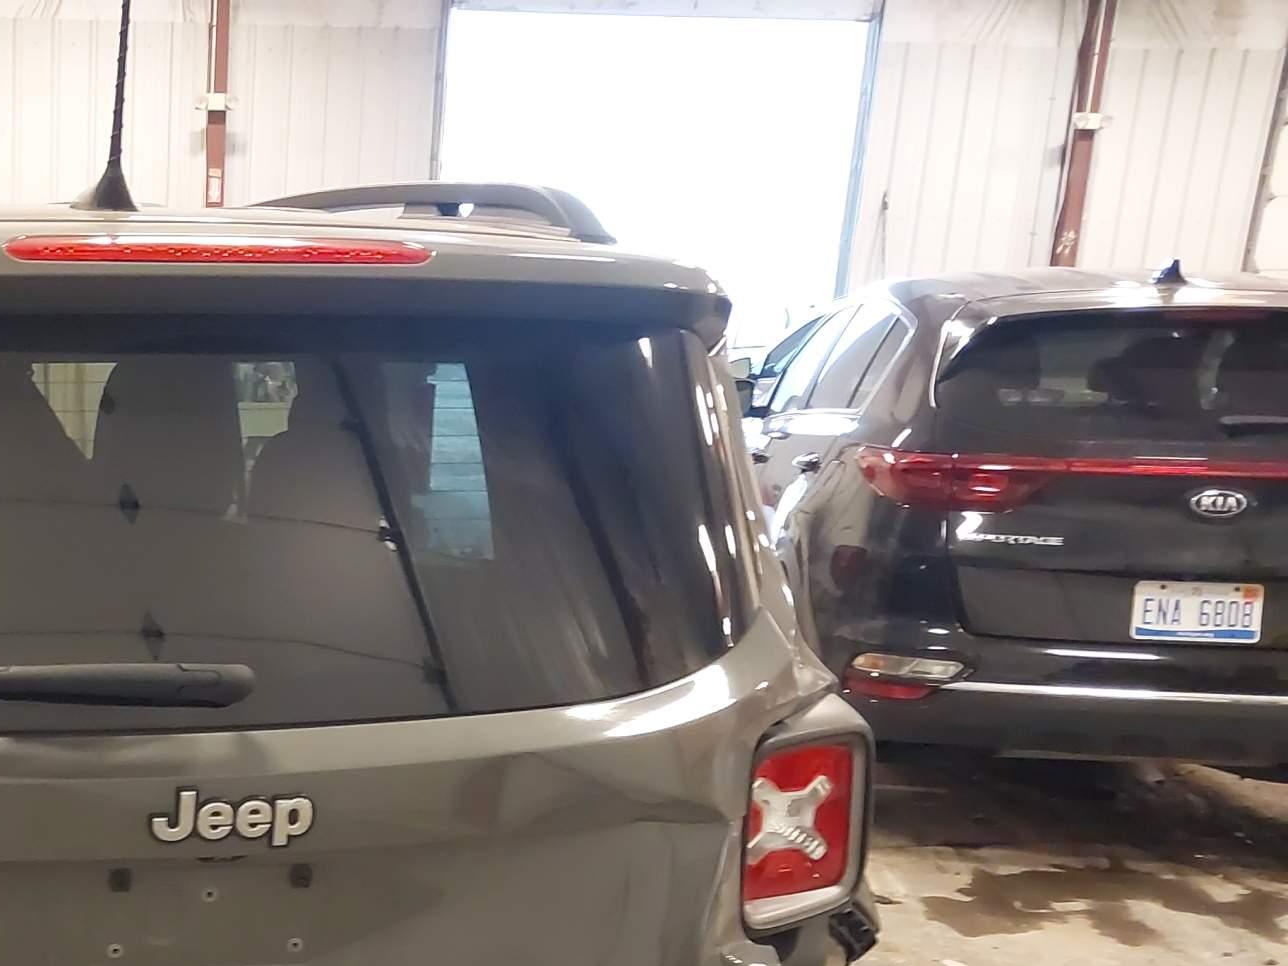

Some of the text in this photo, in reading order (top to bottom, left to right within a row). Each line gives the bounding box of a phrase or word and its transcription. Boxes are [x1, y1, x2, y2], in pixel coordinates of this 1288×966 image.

[1199, 495, 1238, 512] KIA
[1143, 598, 1253, 627] ENA 6808
[151, 790, 313, 847] Jeep
